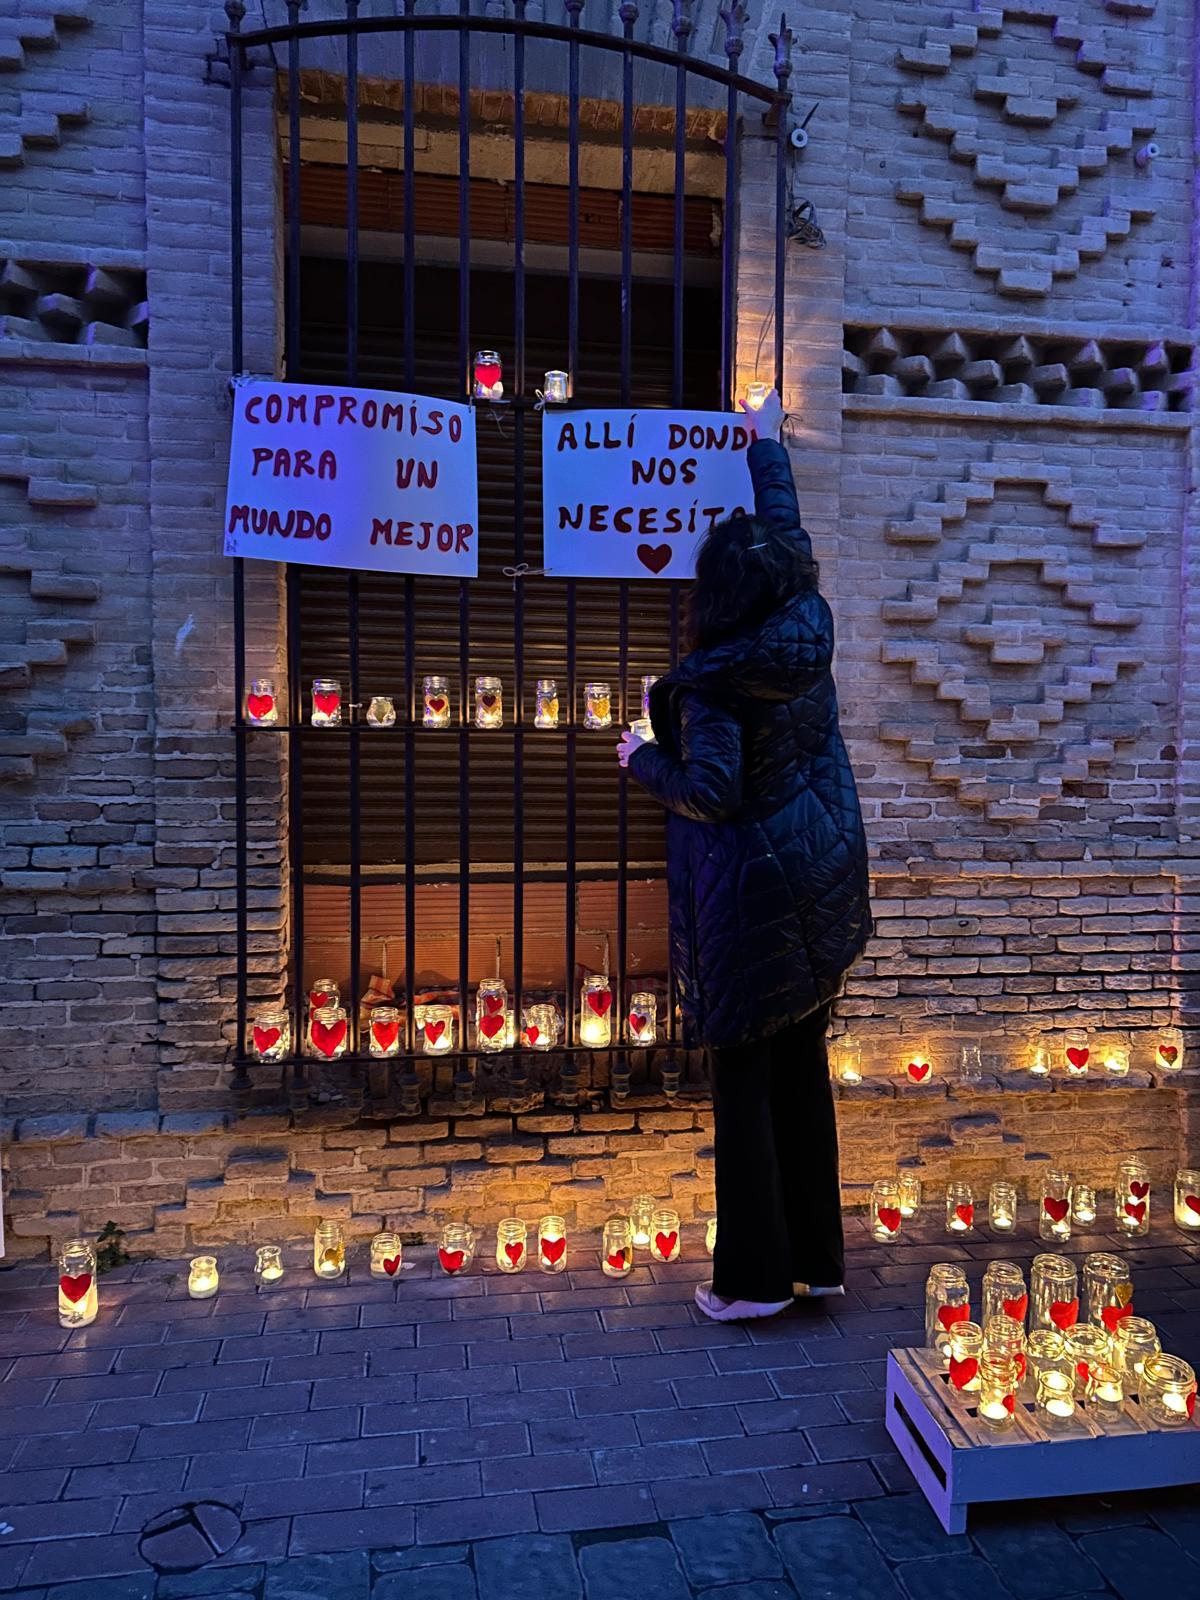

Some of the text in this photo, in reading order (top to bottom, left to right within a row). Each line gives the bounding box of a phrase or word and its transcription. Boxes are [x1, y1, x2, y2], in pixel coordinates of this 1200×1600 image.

[557, 413, 758, 451] ALLÍ DOND
[252, 448, 438, 489] PARA UN
[631, 457, 698, 486] NOS
[228, 505, 474, 553] MUNDO MEJOR
